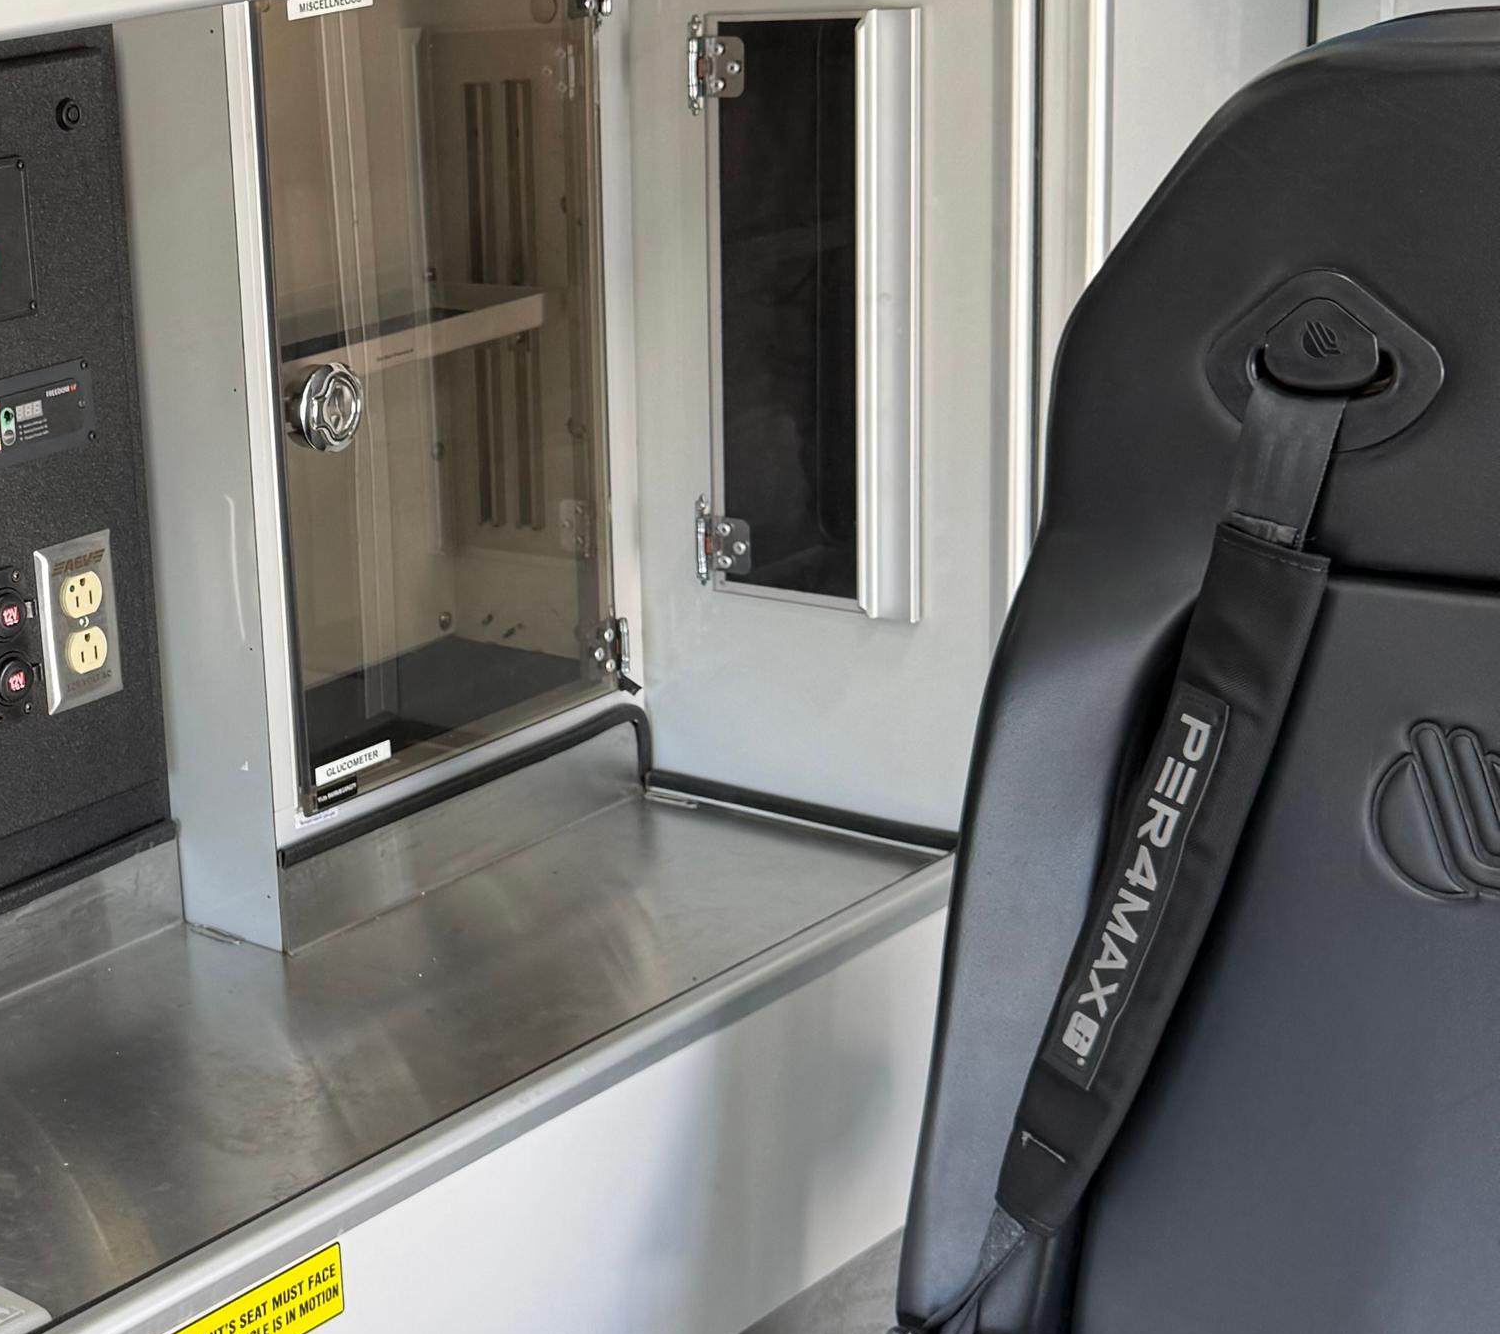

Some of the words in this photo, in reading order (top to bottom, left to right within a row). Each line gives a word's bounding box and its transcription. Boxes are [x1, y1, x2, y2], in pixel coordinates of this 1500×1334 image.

[3, 606, 18, 621] 12V
[9, 671, 25, 687] 12V
[326, 750, 379, 777] GLUCOMETER
[1077, 712, 1211, 1018] PER4MAX
[239, 1301, 268, 1329] SEAT
[272, 1281, 304, 1312] MUST
[308, 1263, 336, 1291] FACE
[273, 1317, 282, 1333] IS
[286, 1310, 297, 1325] IN
[299, 1282, 339, 1318] MOTION
